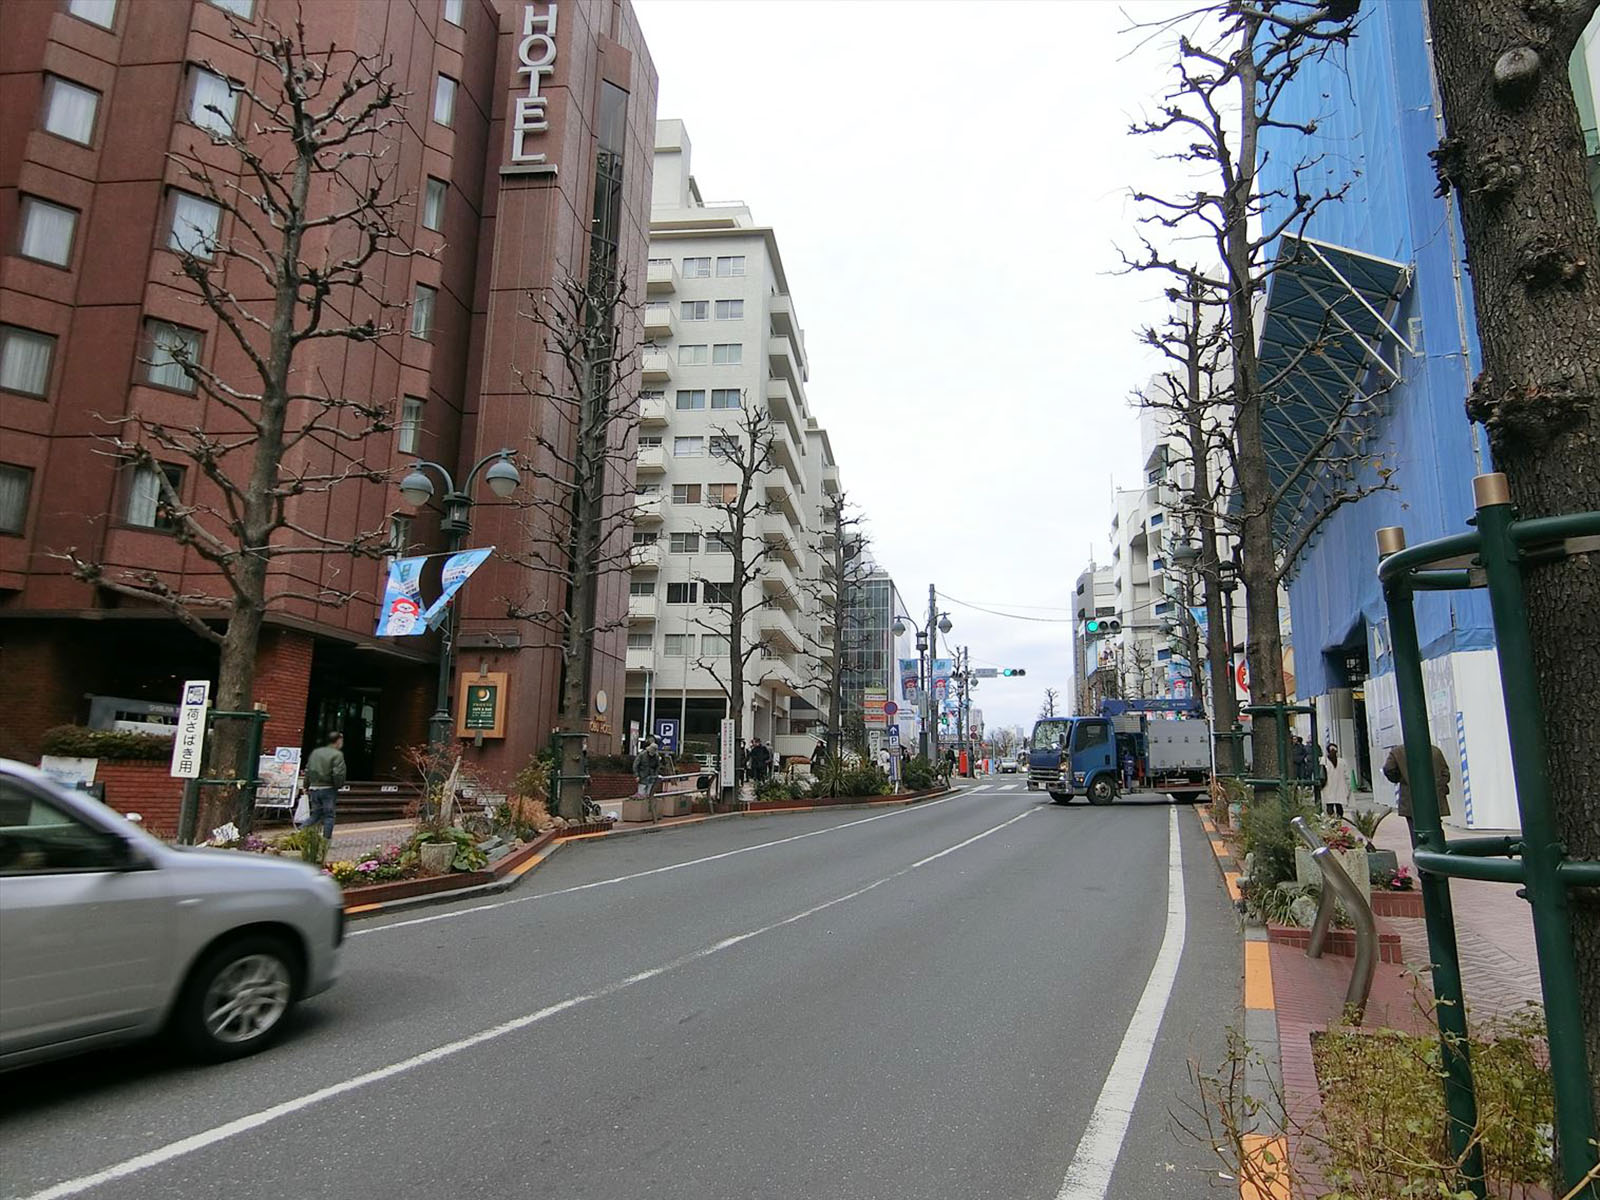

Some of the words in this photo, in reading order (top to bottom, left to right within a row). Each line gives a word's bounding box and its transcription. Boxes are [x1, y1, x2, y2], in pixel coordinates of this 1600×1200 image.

[512, 4, 558, 163] HOTEL
[178, 707, 199, 774] 荷さばき用
[662, 725, 673, 735] P
